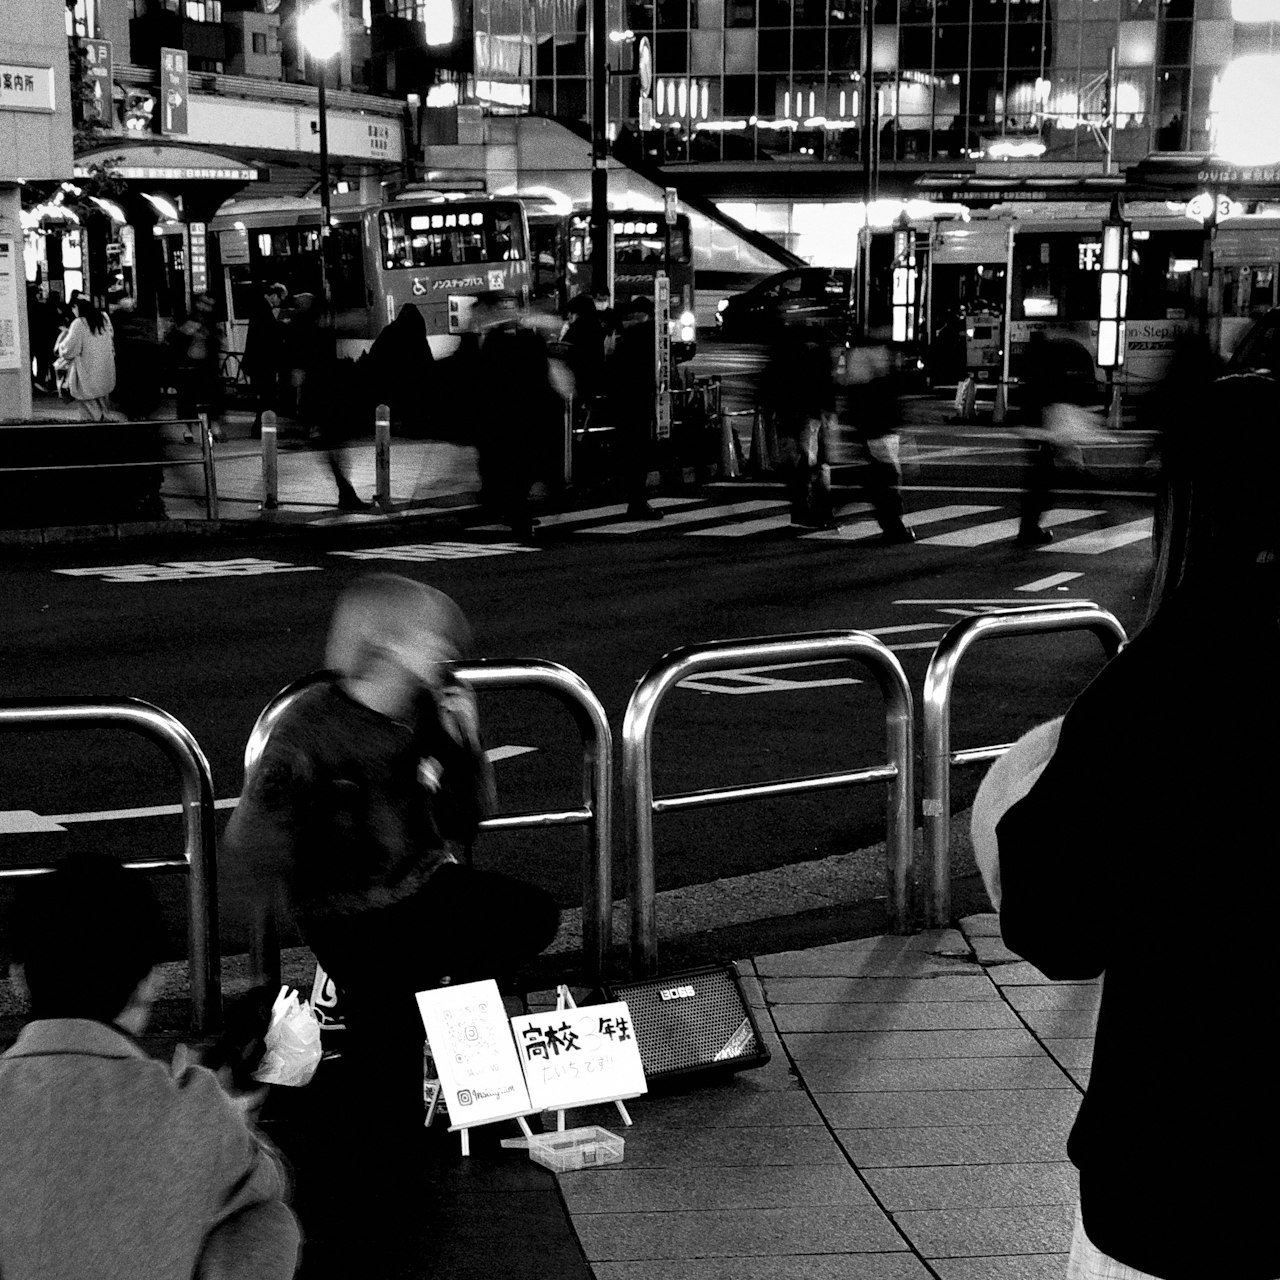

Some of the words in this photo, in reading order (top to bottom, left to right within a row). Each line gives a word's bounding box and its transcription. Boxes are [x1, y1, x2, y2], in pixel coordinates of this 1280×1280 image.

[1219, 200, 1230, 215] 3
[433, 277, 484, 290] ノンステップバス
[660, 985, 695, 1001] BOSS
